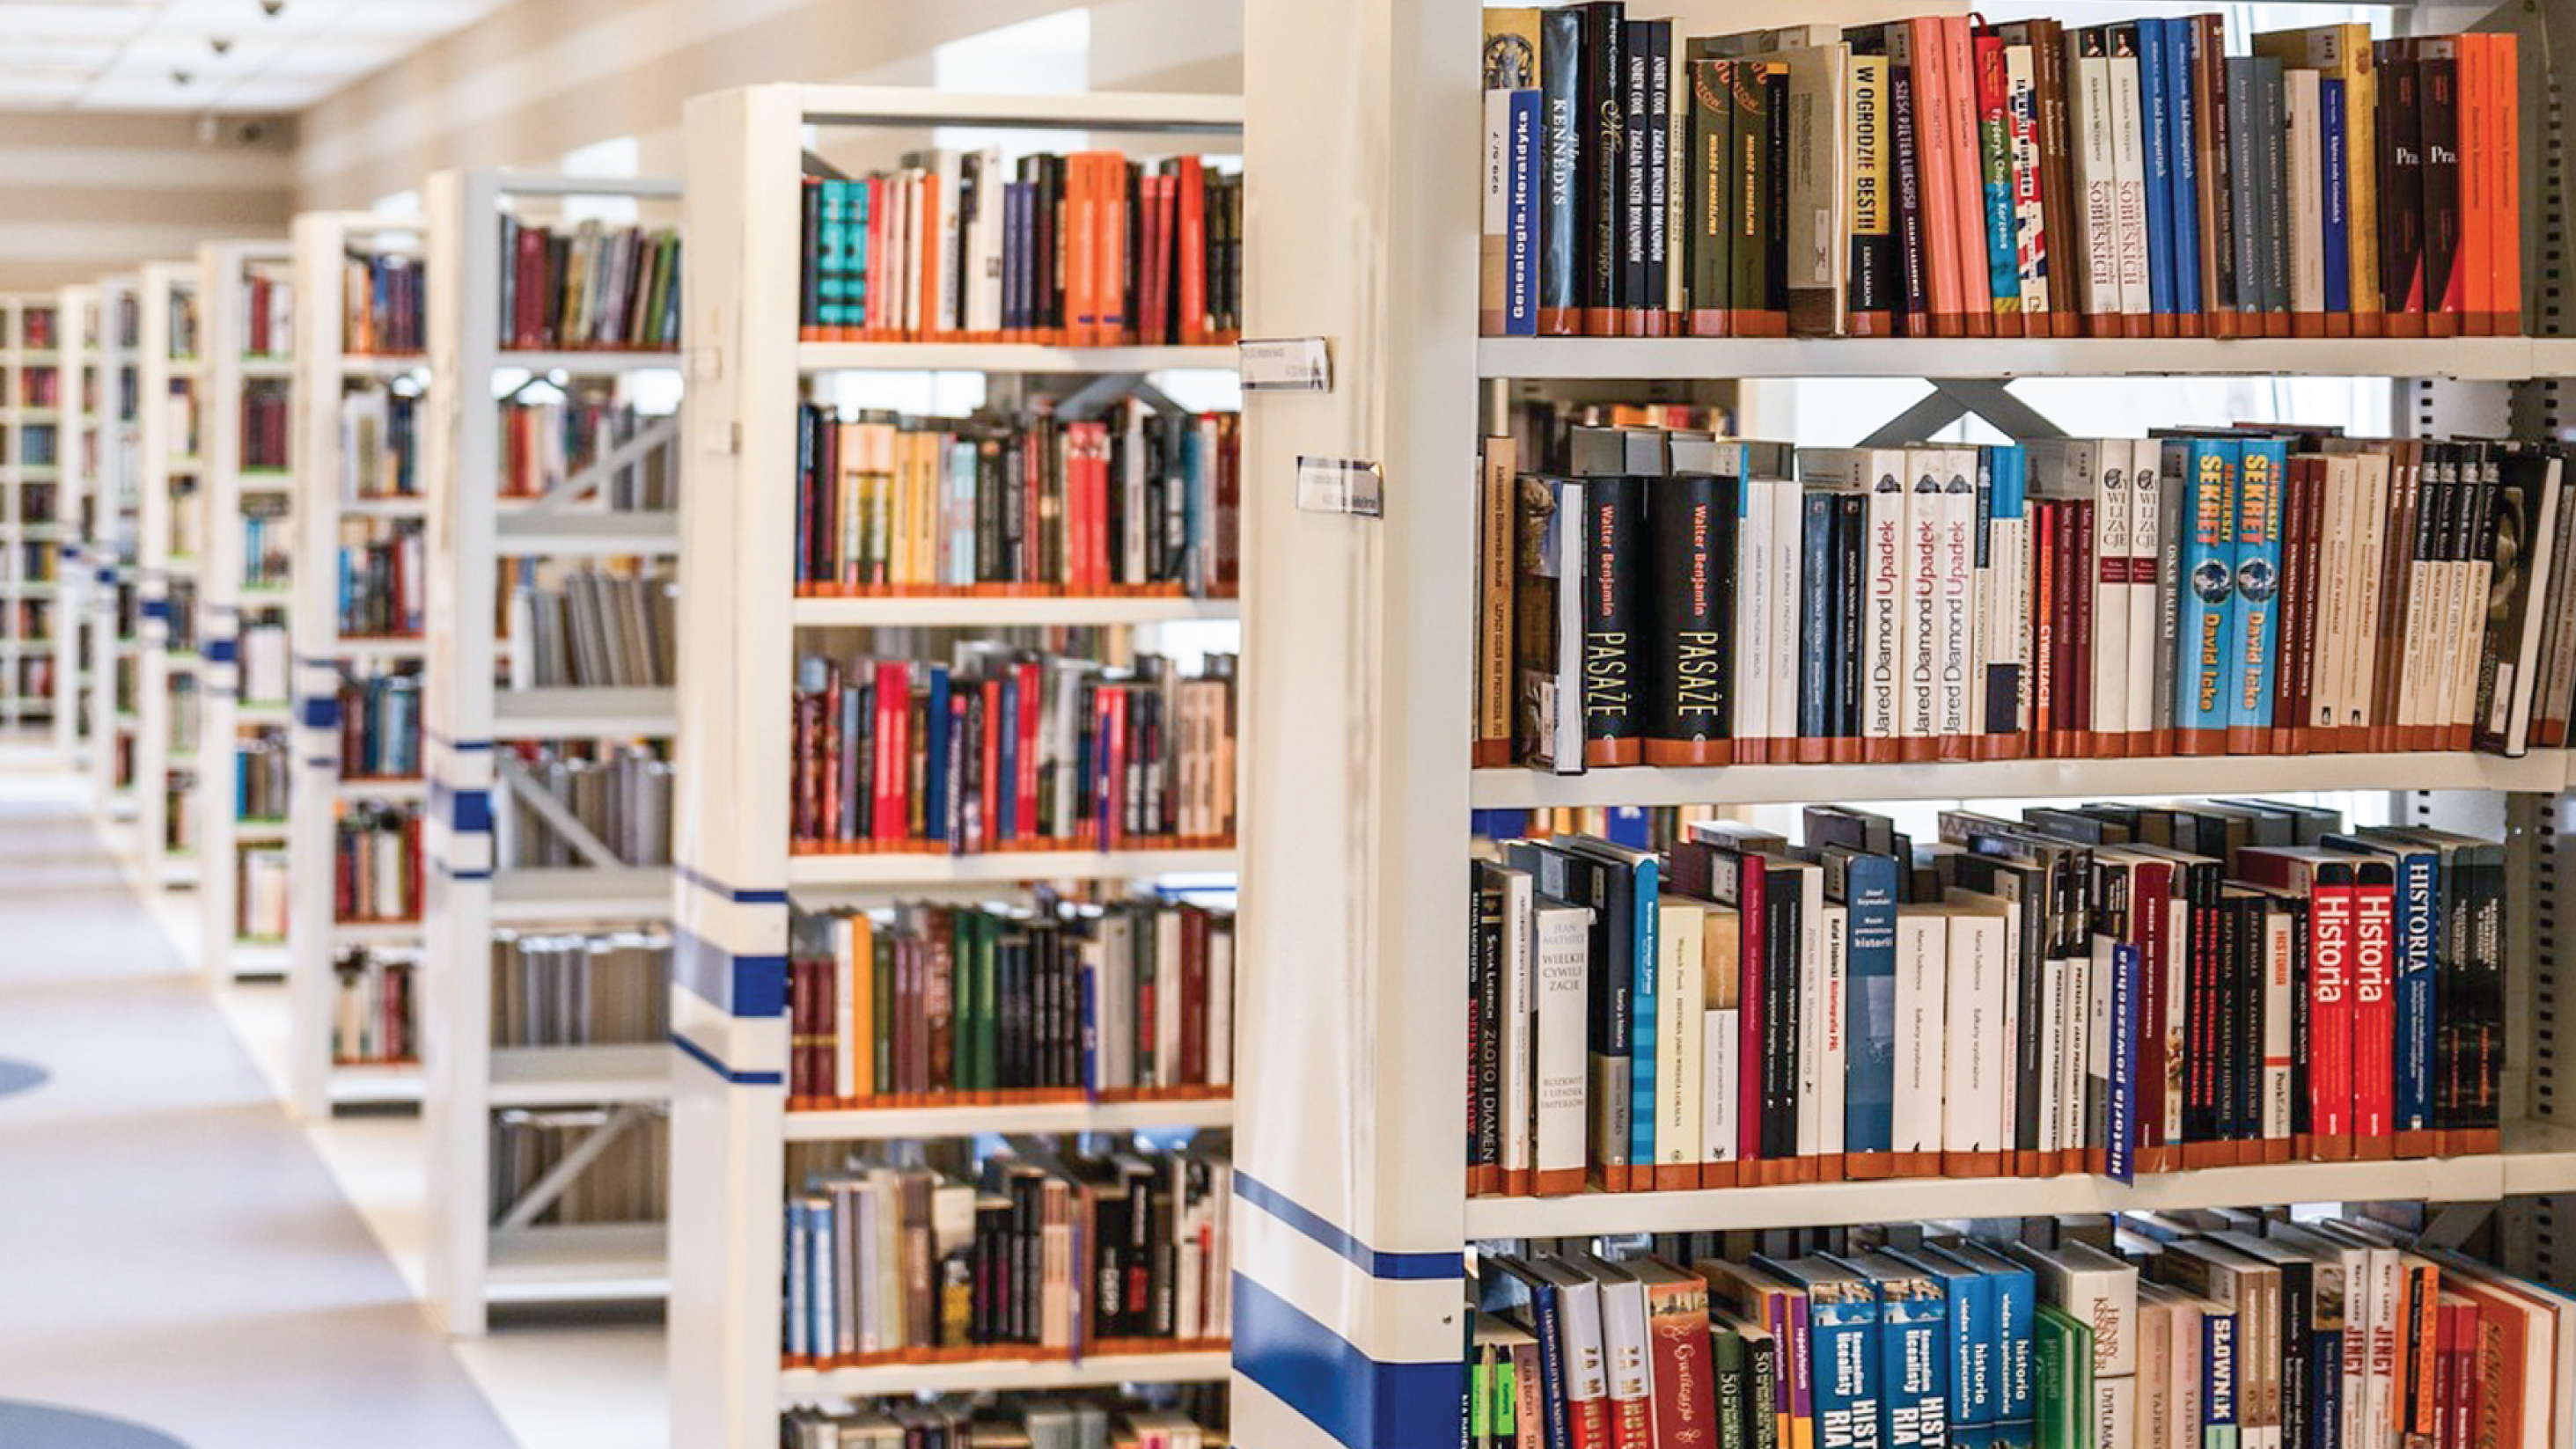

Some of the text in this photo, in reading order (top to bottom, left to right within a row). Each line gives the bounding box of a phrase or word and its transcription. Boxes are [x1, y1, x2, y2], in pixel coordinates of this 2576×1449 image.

[1630, 56, 1643, 89] ANDREW
[1653, 56, 1666, 89] ANDREW
[1630, 91, 1643, 114] COOK
[1652, 91, 1665, 114] COOK
[2015, 79, 2029, 133] TAJEMNICE
[2181, 99, 2191, 118] Ród
[1552, 99, 1567, 206] KENNEDYS
[1629, 129, 1643, 165] ZAGŁADA
[1652, 129, 1665, 165] ZAGŁADA
[1857, 66, 1875, 229] W OGRODZIE BESTII
[1901, 157, 1916, 209] LUKSUSU
[1990, 108, 2004, 157] Fryderyk
[1998, 203, 2008, 249] Korzenie
[1628, 206, 1644, 262] ROMANOWÓW
[1651, 206, 1666, 262] ROMANOWÓW
[2090, 181, 2106, 285] SOBIESKICH
[2120, 181, 2136, 285] SOBIESKICH
[2108, 520, 2125, 532] ZA
[2140, 520, 2156, 532] ZA
[2198, 456, 2220, 546] SEKRET
[2241, 454, 2268, 546] SEKRET
[1598, 506, 1614, 616] Walter Benjamin
[1691, 506, 1706, 616] Walter Benjamin
[2166, 545, 2176, 583] OSKAR
[1875, 521, 1897, 738] Jared Diamond Upadek
[1914, 521, 1937, 737] Jared Diamond Upadek
[1944, 521, 1966, 736] Jared Diamond Upadek
[2163, 589, 2176, 639] HALECKI
[1588, 632, 1632, 716] PASAŻE
[1677, 632, 1723, 716] PASAŻE
[2038, 625, 2051, 707] CYWILIZACJE
[2200, 614, 2220, 712] David Icke
[2244, 611, 2265, 710] David Icke
[1854, 935, 1893, 948] historii
[1916, 929, 1925, 952] Maria
[2408, 862, 2429, 973] HISTORIA
[1486, 935, 1497, 969] SILVIA
[1829, 918, 1840, 978] Rafał Stobiecki
[1974, 929, 1984, 991] Maria Todorova
[2274, 931, 2288, 986] HISTORIA
[2316, 896, 2350, 1003] Historia
[2359, 896, 2390, 1002] Historia
[1549, 980, 1579, 992] ZACJE
[1615, 987, 1626, 1011] Teoria
[2223, 991, 2233, 1006] NA
[2249, 989, 2257, 1005] NA
[1615, 1019, 1626, 1048] historia
[1828, 980, 1838, 1051] Historiografia PRL
[1913, 1008, 1924, 1038] Bałkany
[1971, 1008, 1982, 1038] Bałkany
[1484, 1029, 1498, 1082] ZŁOTO
[2111, 950, 2128, 1175] Historia powszechna
[2094, 1297, 2107, 1372] KISSINGER
[2105, 1307, 2120, 1359] HENRY
[1721, 1373, 1740, 1394] 50
[1755, 1352, 1770, 1373] 50
[1835, 1332, 1852, 1396] licealisty
[1904, 1330, 1920, 1393] licealisty
[1975, 1343, 1988, 1404] historia
[2015, 1339, 2029, 1401] historia
[1824, 1410, 1852, 1448] RIA
[1853, 1400, 1876, 1449] HIST
[1892, 1408, 1919, 1445] RIA
[1920, 1397, 1945, 1447] HIST
